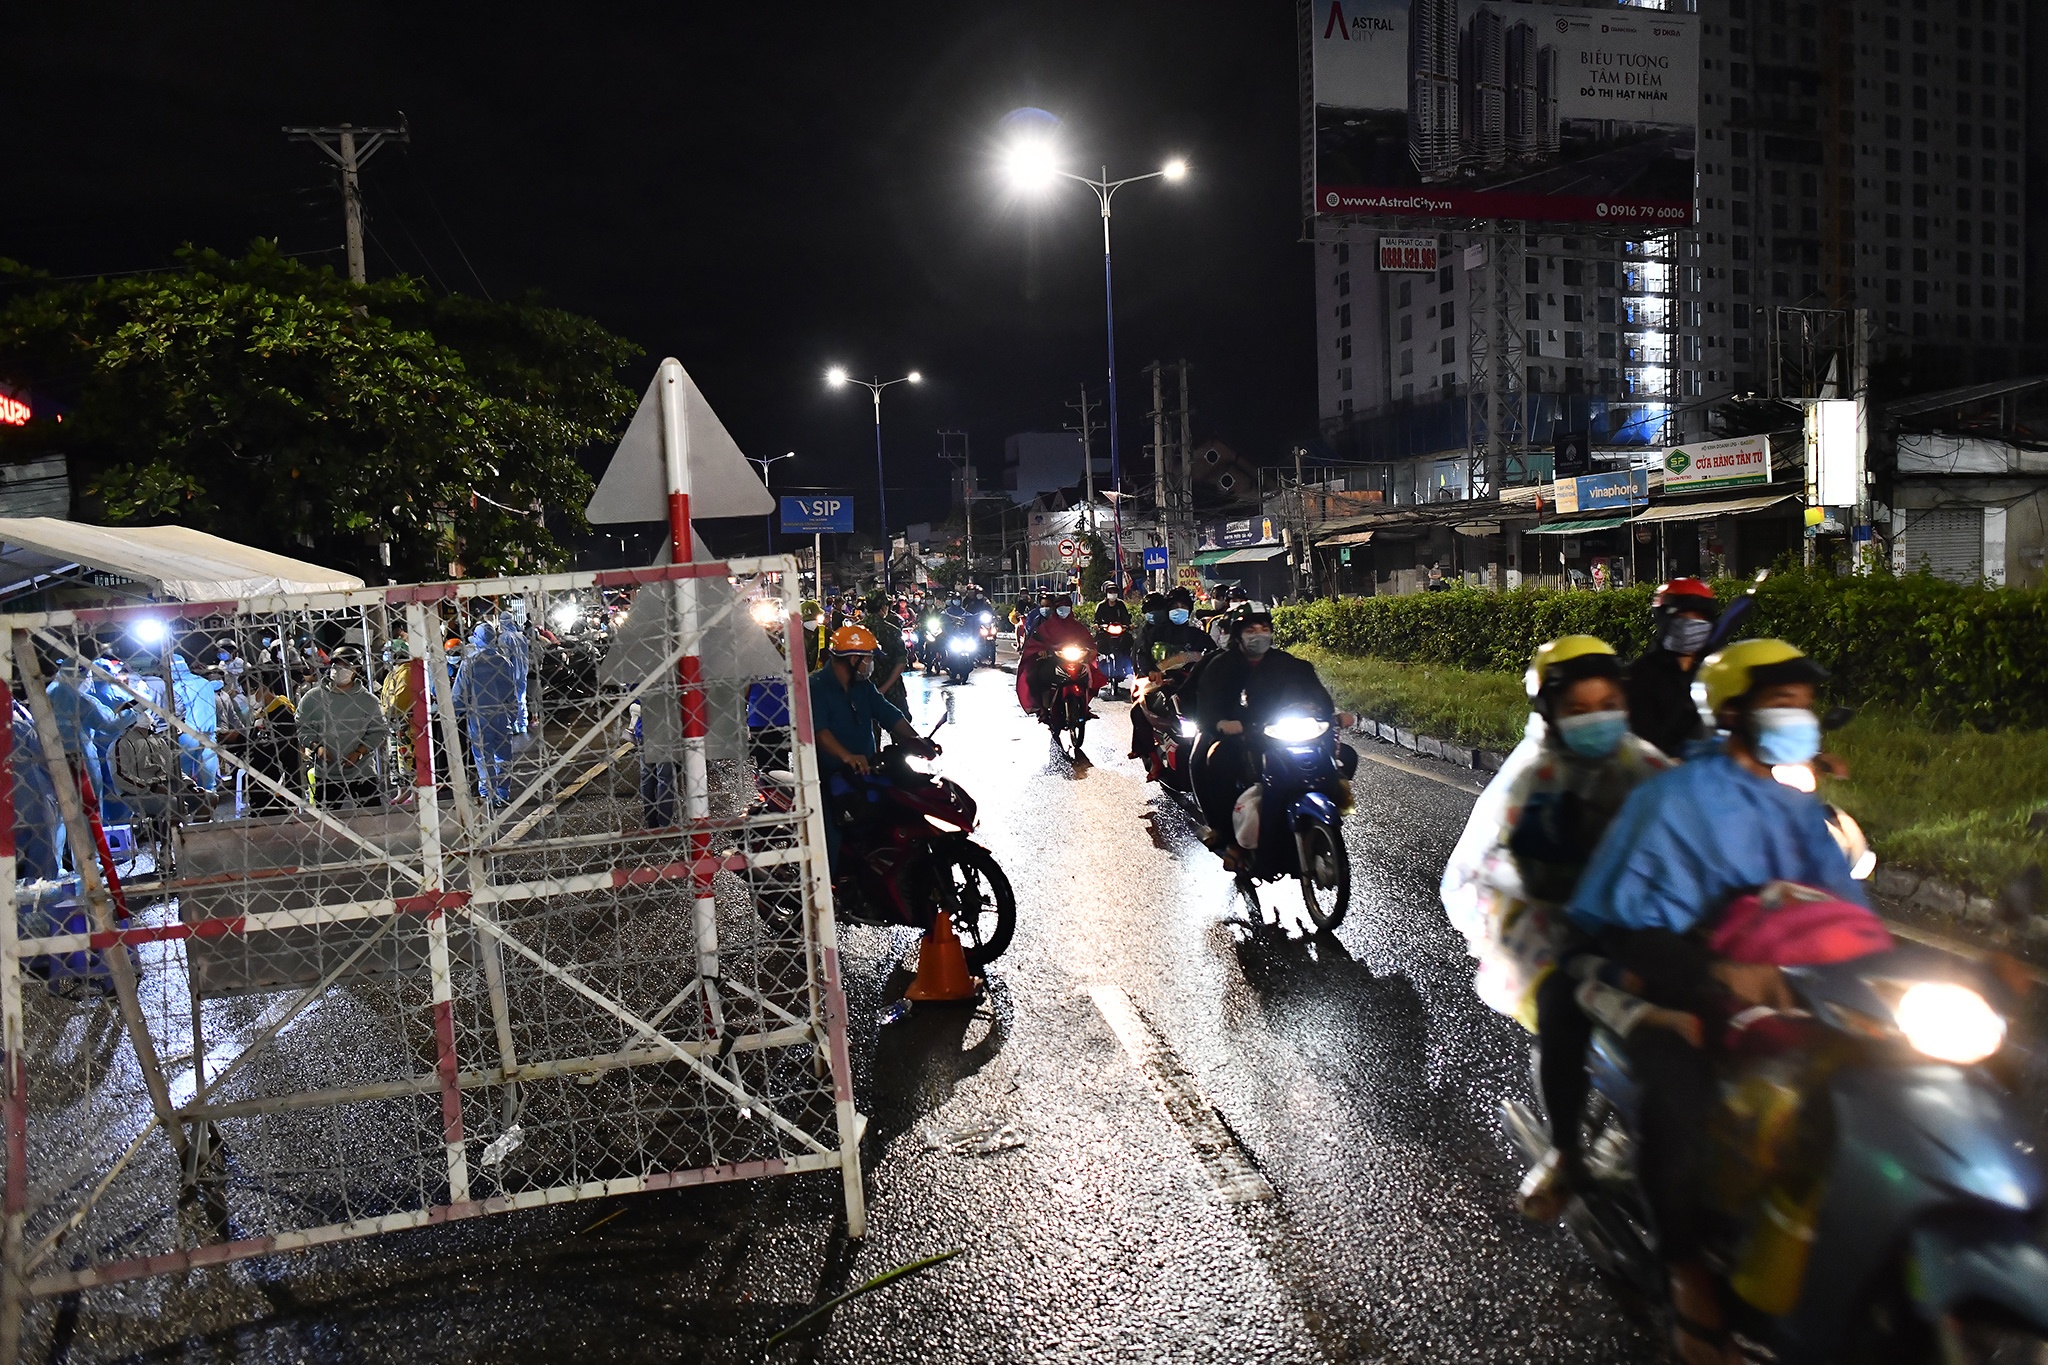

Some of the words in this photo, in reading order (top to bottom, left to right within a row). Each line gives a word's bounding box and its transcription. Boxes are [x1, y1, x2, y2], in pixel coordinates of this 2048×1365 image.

[1352, 17, 1394, 31] ASTRAL
[1352, 30, 1374, 41] CITY
[1589, 68, 1620, 84] TÂM
[1580, 86, 1595, 97] ĐÔ
[1598, 89, 1613, 99] THỊ
[1616, 90, 1635, 100] HẠT
[1638, 90, 1668, 101] NHÂN
[1342, 196, 1452, 211] www.AstralCity.vn
[1610, 205, 1637, 216] 0916
[1640, 206, 1654, 217] 79
[1657, 207, 1685, 218] 6006
[1670, 457, 1685, 466] SP
[1695, 455, 1712, 470] CỬA
[1713, 453, 1735, 468] HÀNG
[1589, 483, 1639, 499] vinaphone
